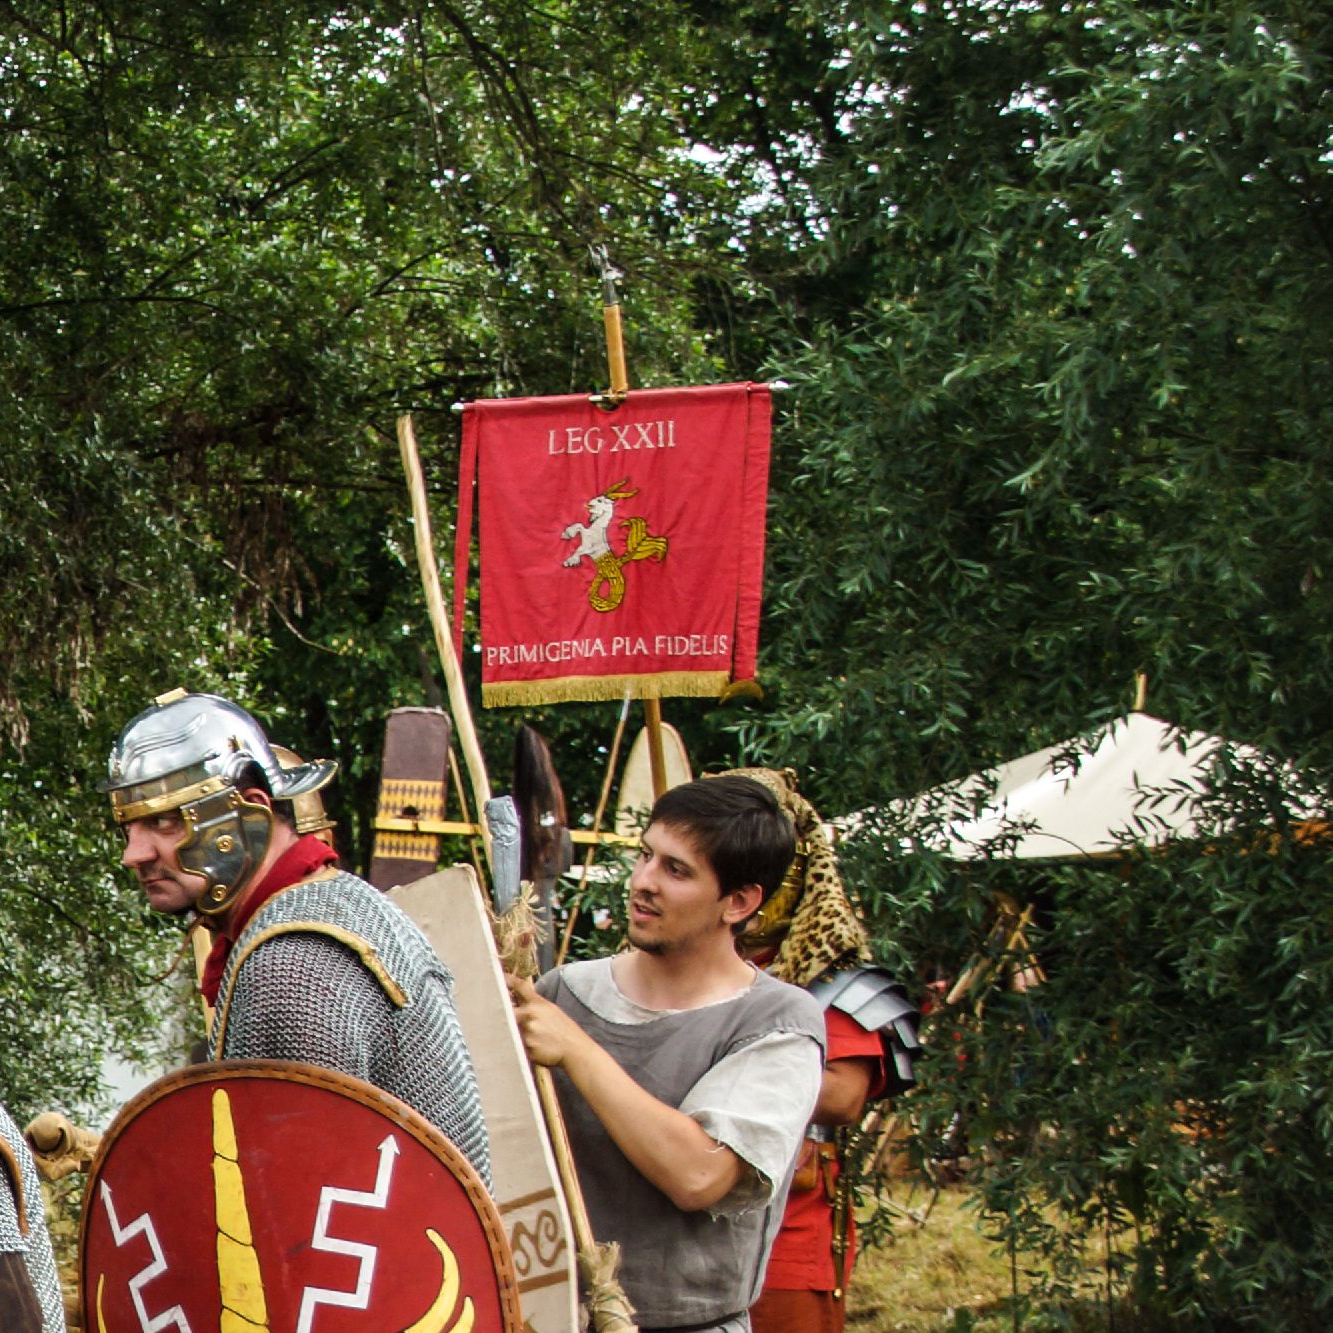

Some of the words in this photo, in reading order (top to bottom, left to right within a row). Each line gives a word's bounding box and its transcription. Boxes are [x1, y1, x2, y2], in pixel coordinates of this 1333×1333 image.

[549, 427, 604, 454] LEG
[610, 420, 676, 452] XXII
[611, 636, 648, 656] PIA
[654, 634, 728, 656] FIDELIS
